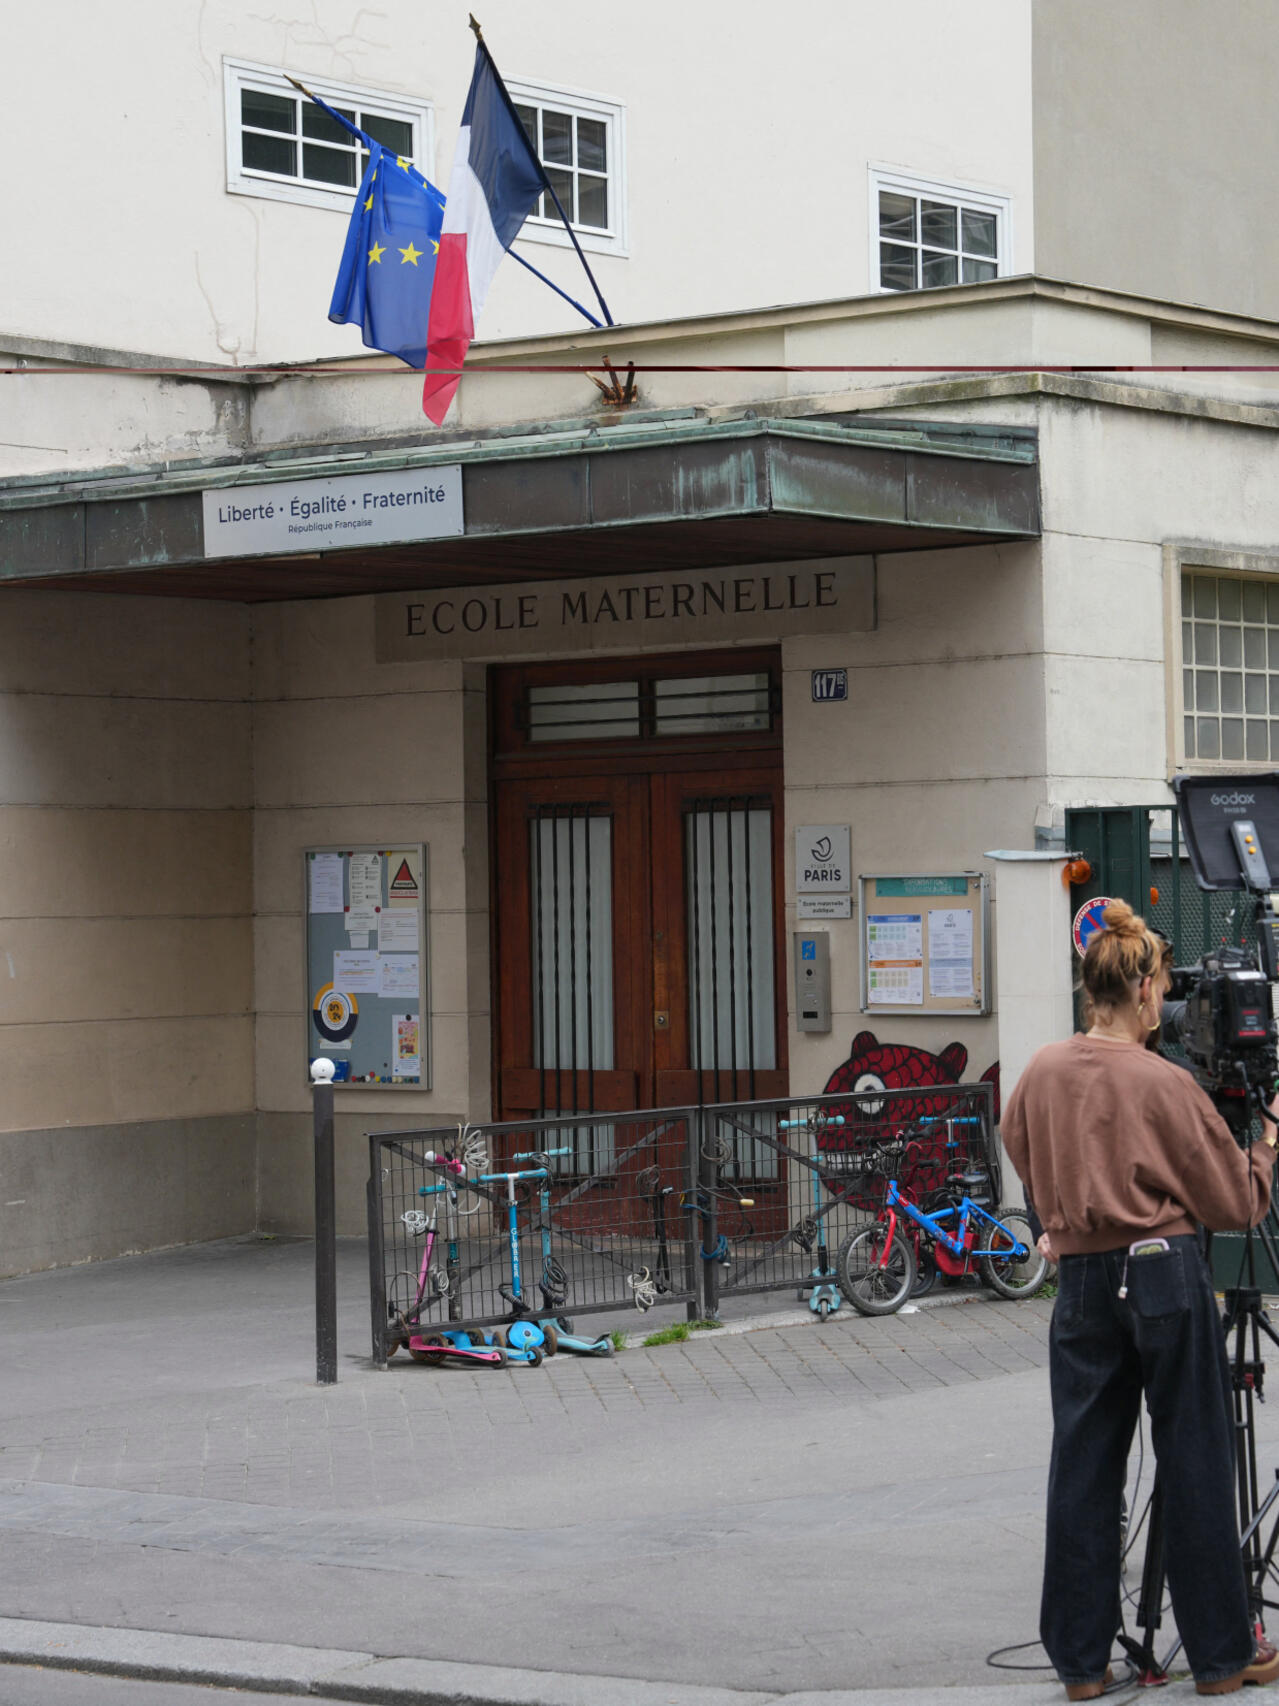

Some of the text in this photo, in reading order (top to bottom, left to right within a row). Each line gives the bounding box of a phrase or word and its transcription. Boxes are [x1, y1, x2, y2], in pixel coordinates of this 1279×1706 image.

[218, 485, 446, 523] Liberté Égalité Fraternité
[288, 518, 373, 533] République Française
[406, 571, 838, 637] ECOLE MATERNELLE
[815, 673, 837, 697] 117
[1210, 791, 1256, 806] Godox
[804, 868, 842, 881] PARIS
